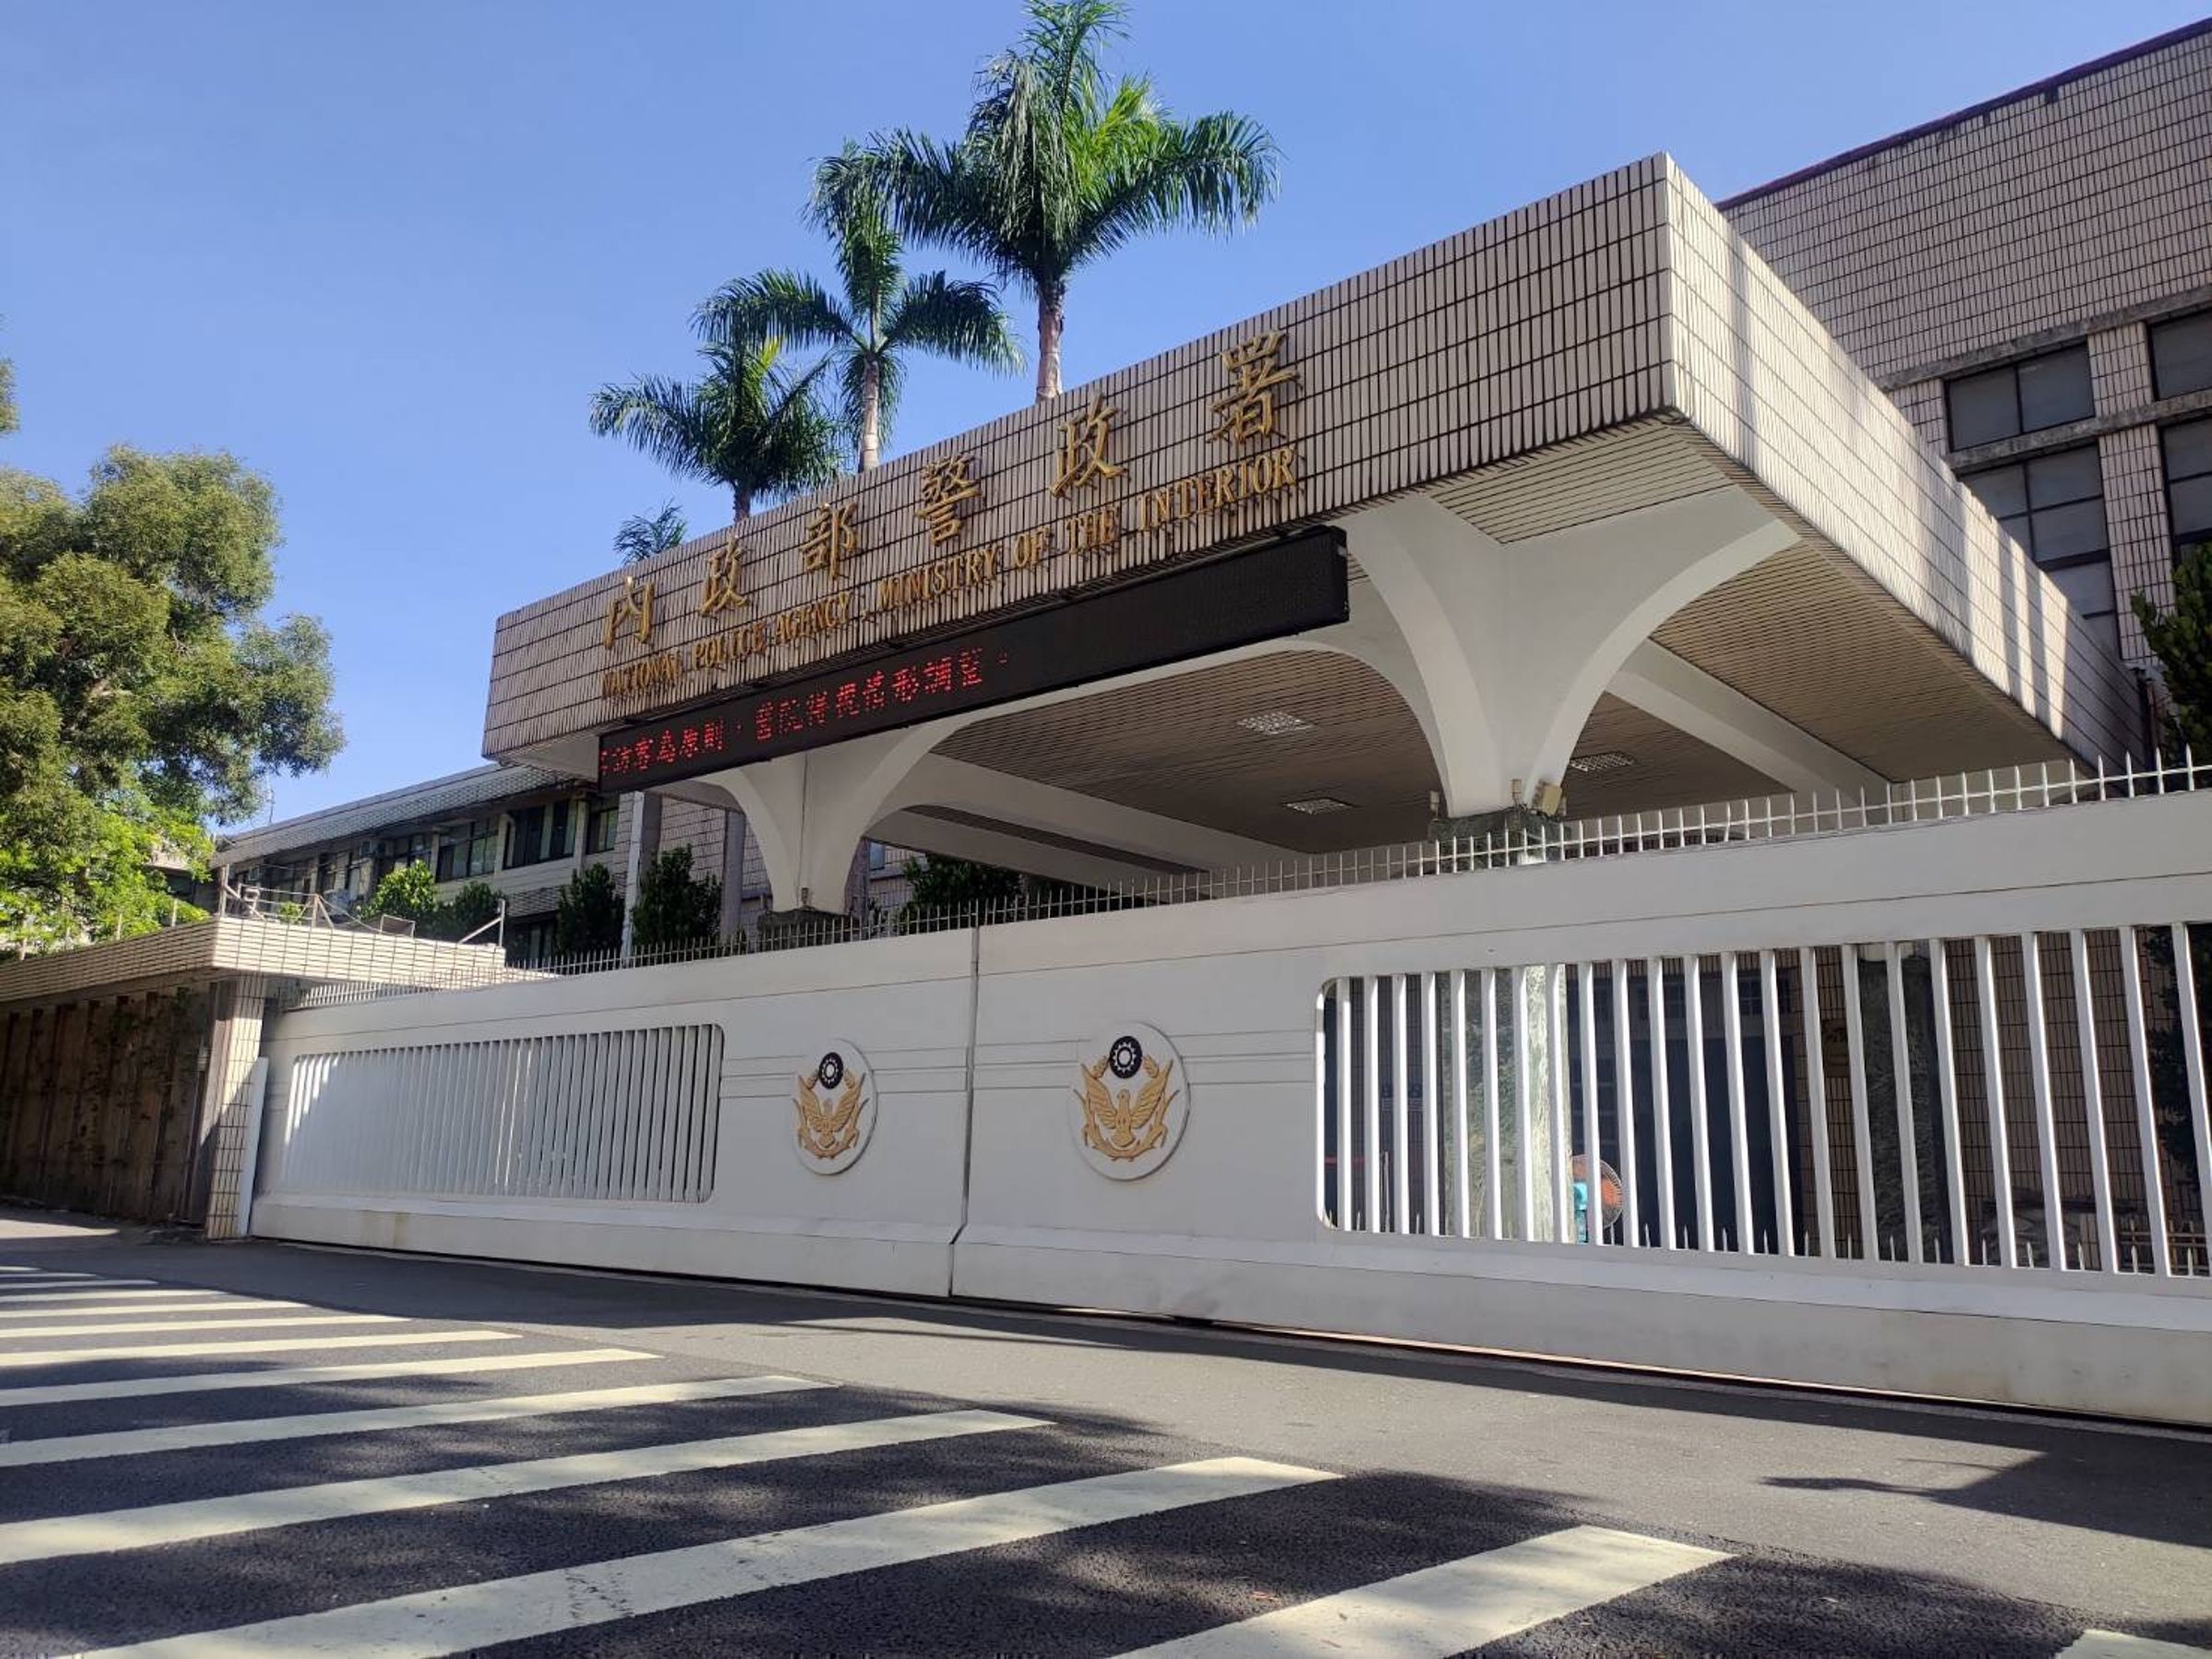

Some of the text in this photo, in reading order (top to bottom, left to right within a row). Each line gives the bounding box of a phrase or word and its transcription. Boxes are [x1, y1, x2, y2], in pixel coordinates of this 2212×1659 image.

[601, 654, 680, 698] NATIONAL
[696, 623, 766, 669] POLICE
[879, 545, 997, 608] MINISTRY
[1014, 528, 1050, 569] OF
[1065, 507, 1120, 553] THE
[1138, 447, 1297, 531] INTERIOR
[605, 329, 1299, 648] 內政部警政署
